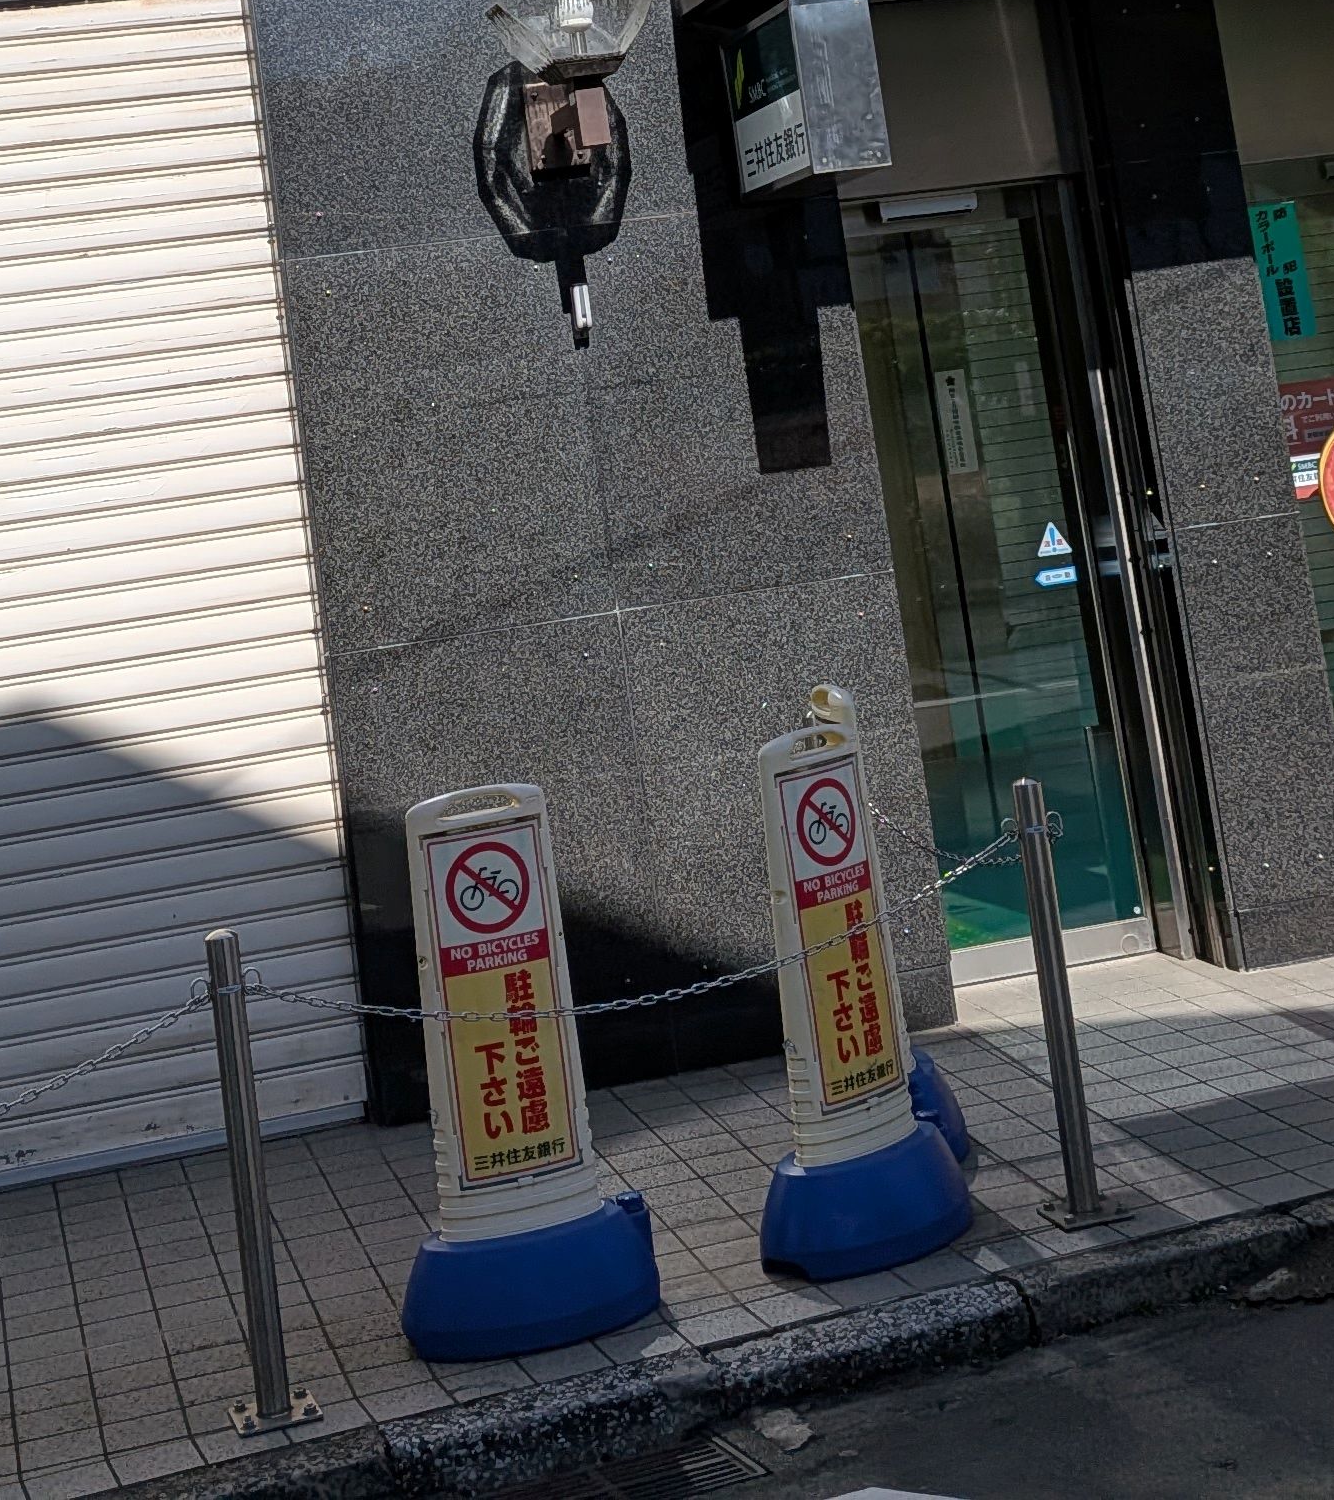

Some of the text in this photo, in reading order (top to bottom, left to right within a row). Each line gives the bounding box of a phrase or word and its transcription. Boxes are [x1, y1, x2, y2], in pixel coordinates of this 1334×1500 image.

[745, 123, 806, 177] 三井住友銀行
[1255, 210, 1279, 277] カラーボール
[1275, 278, 1302, 336] 設置店
[1298, 461, 1317, 471] SMBC
[803, 864, 865, 893] NO BICYCLES
[818, 880, 859, 903] PARKING
[451, 932, 540, 961] NO BICYCLES
[467, 948, 528, 972] PARKING
[827, 969, 861, 1064] 下さい
[504, 968, 550, 1135] 駐輪ご遠慮
[474, 1041, 514, 1140] 下さい
[831, 1058, 894, 1096] 三井住友銀行
[474, 1137, 565, 1171] 三井住友銀行
